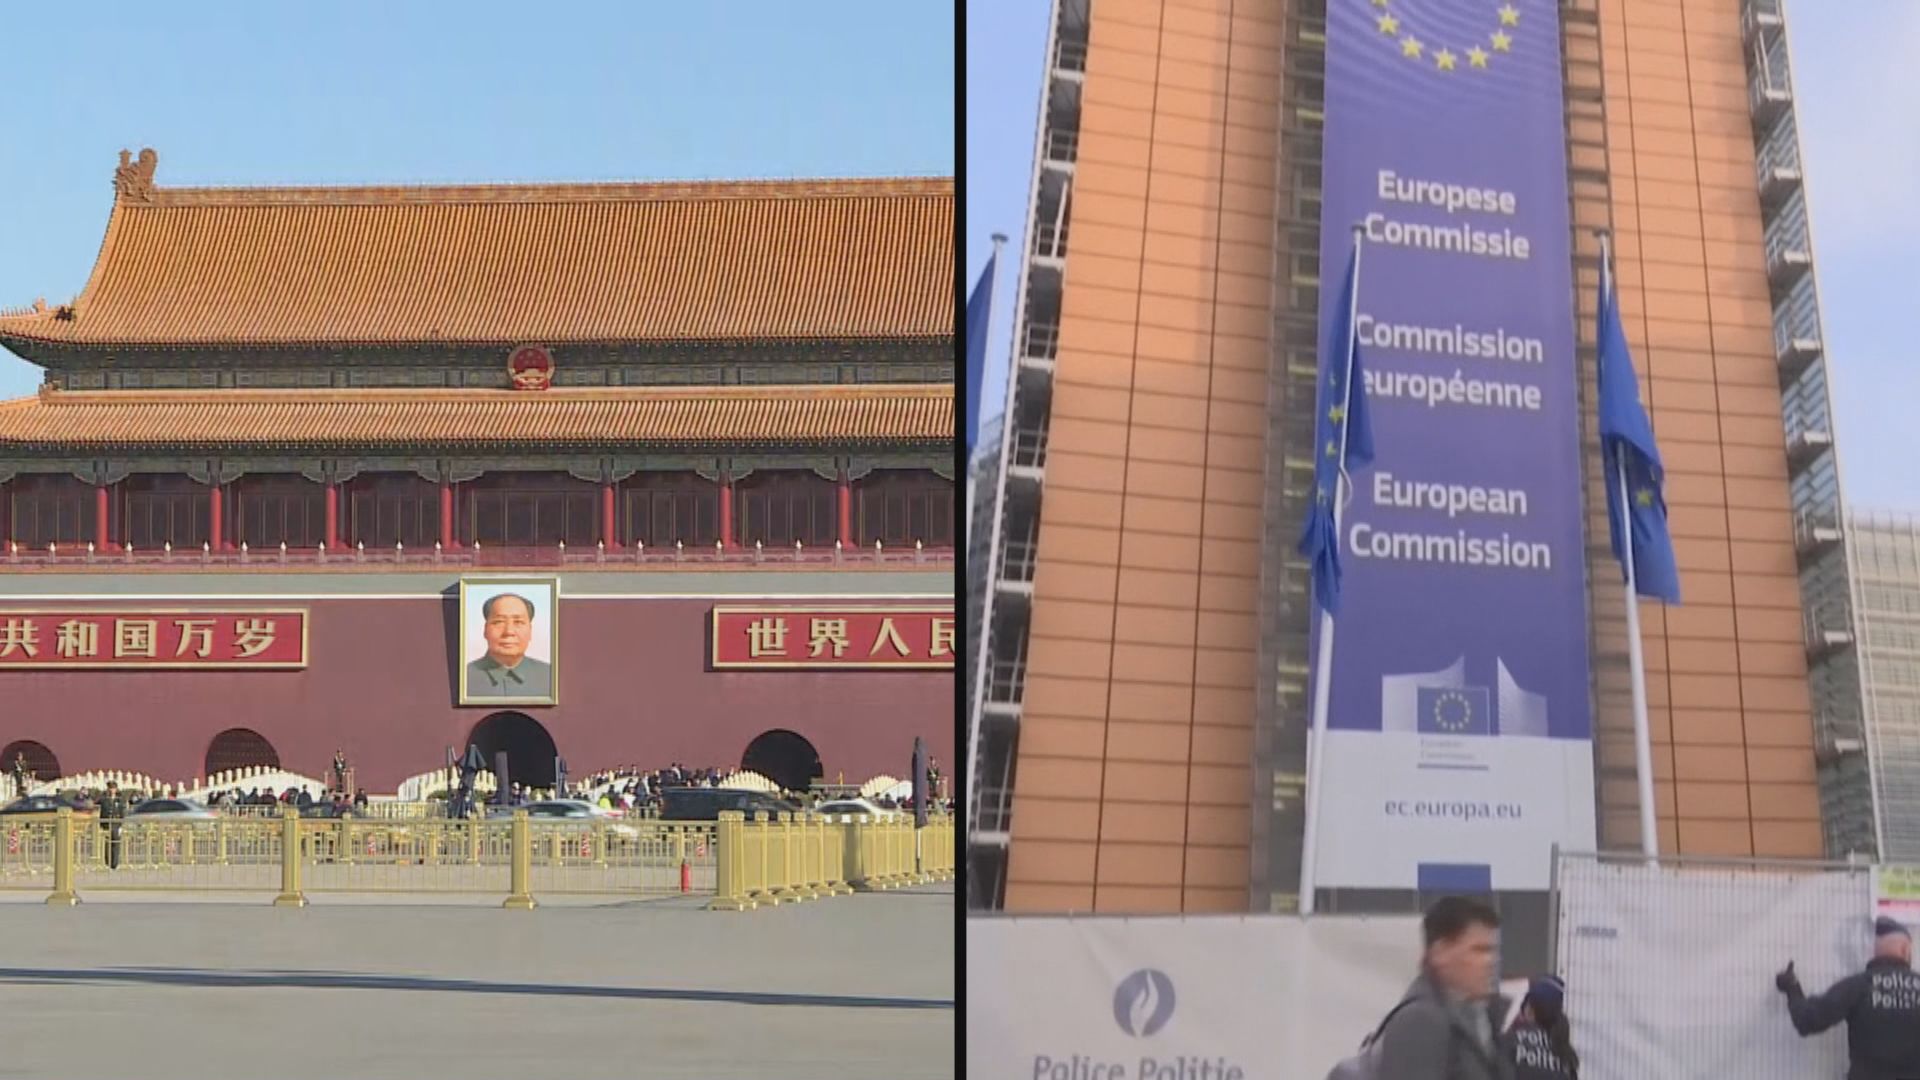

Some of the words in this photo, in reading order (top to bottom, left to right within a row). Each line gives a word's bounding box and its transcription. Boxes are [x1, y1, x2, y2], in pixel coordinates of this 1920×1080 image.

[1377, 169, 1516, 214] Europese
[1364, 212, 1531, 259] Commissie
[1356, 313, 1544, 363] Commission
[1373, 471, 1528, 518] European
[1350, 523, 1551, 570] Commission
[0, 618, 278, 659] 共和国万岁
[1384, 800, 1523, 822] ec.europa.eu
[1516, 1029, 1552, 1050] Poli
[1034, 1054, 1126, 1080] Police
[1138, 1055, 1244, 1080] Politie
